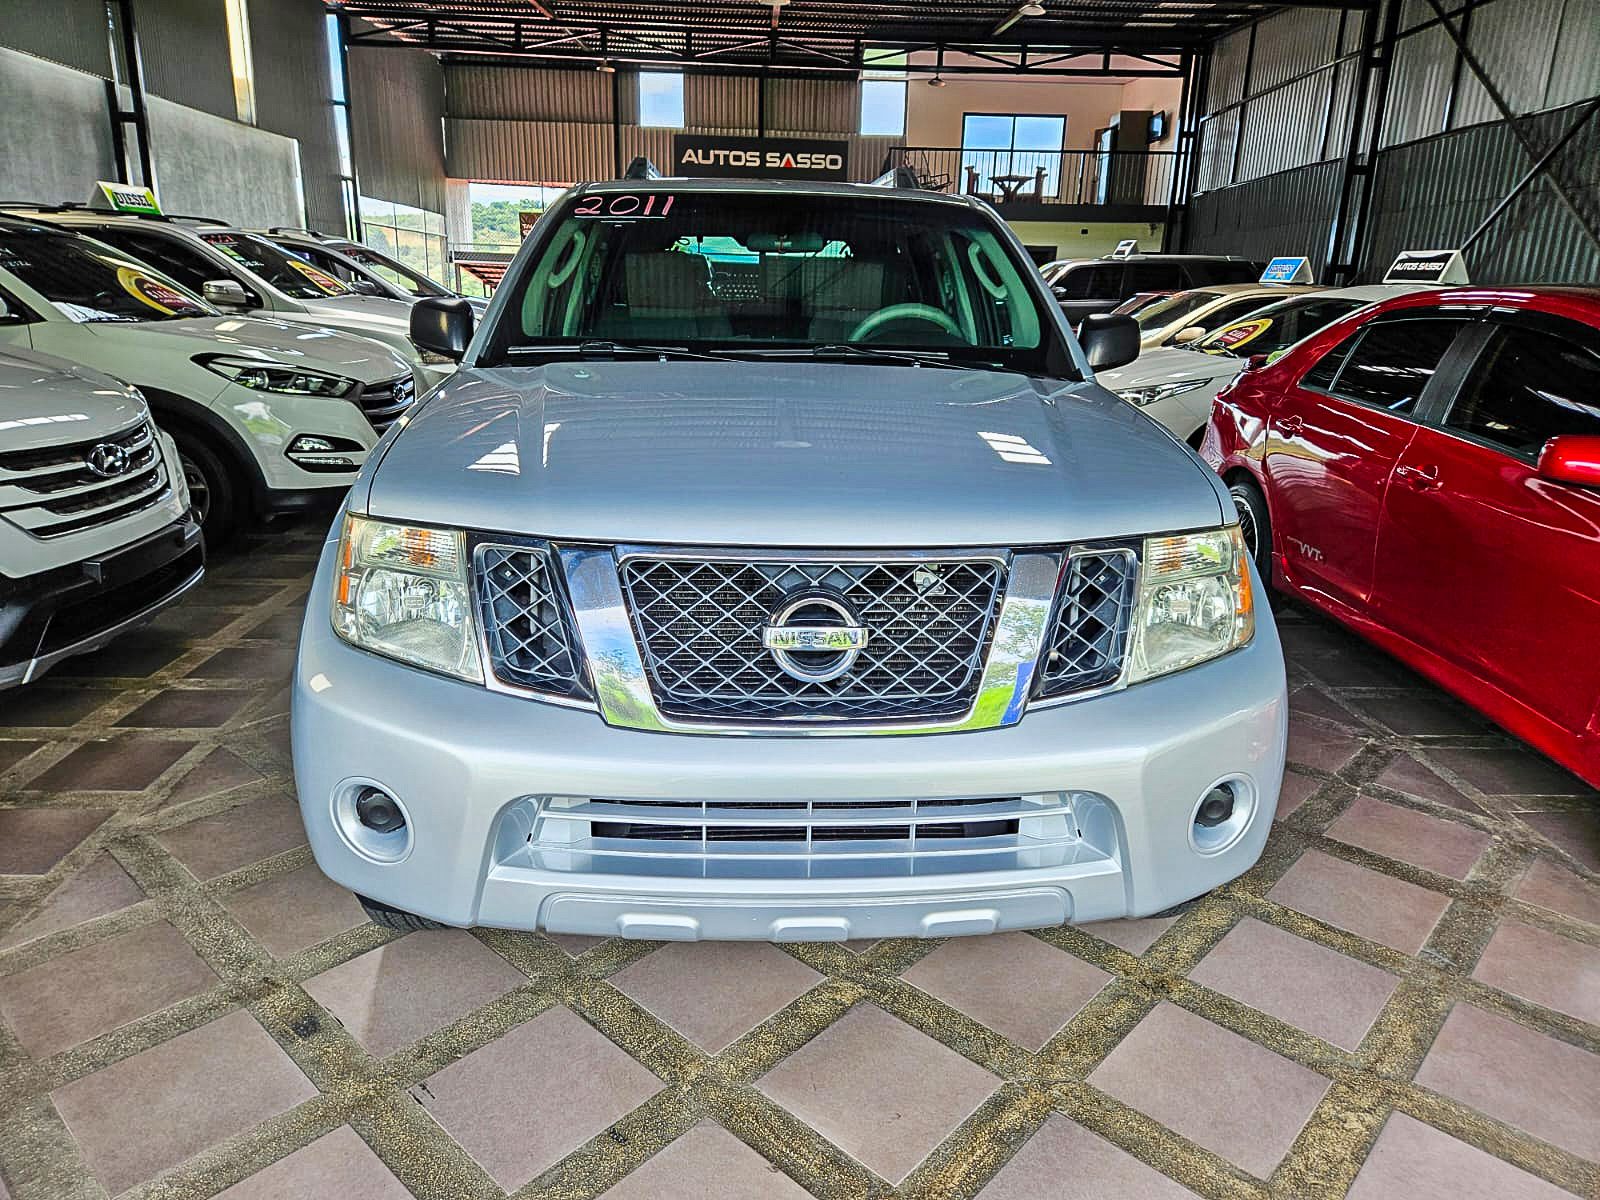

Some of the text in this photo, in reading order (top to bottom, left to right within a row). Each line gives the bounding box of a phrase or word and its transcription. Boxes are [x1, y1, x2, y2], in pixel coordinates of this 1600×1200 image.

[681, 149, 843, 170] AUTOS SASSO
[574, 195, 674, 216] 2011
[1393, 262, 1419, 271] AUTOS
[773, 630, 858, 646] NISSAN
